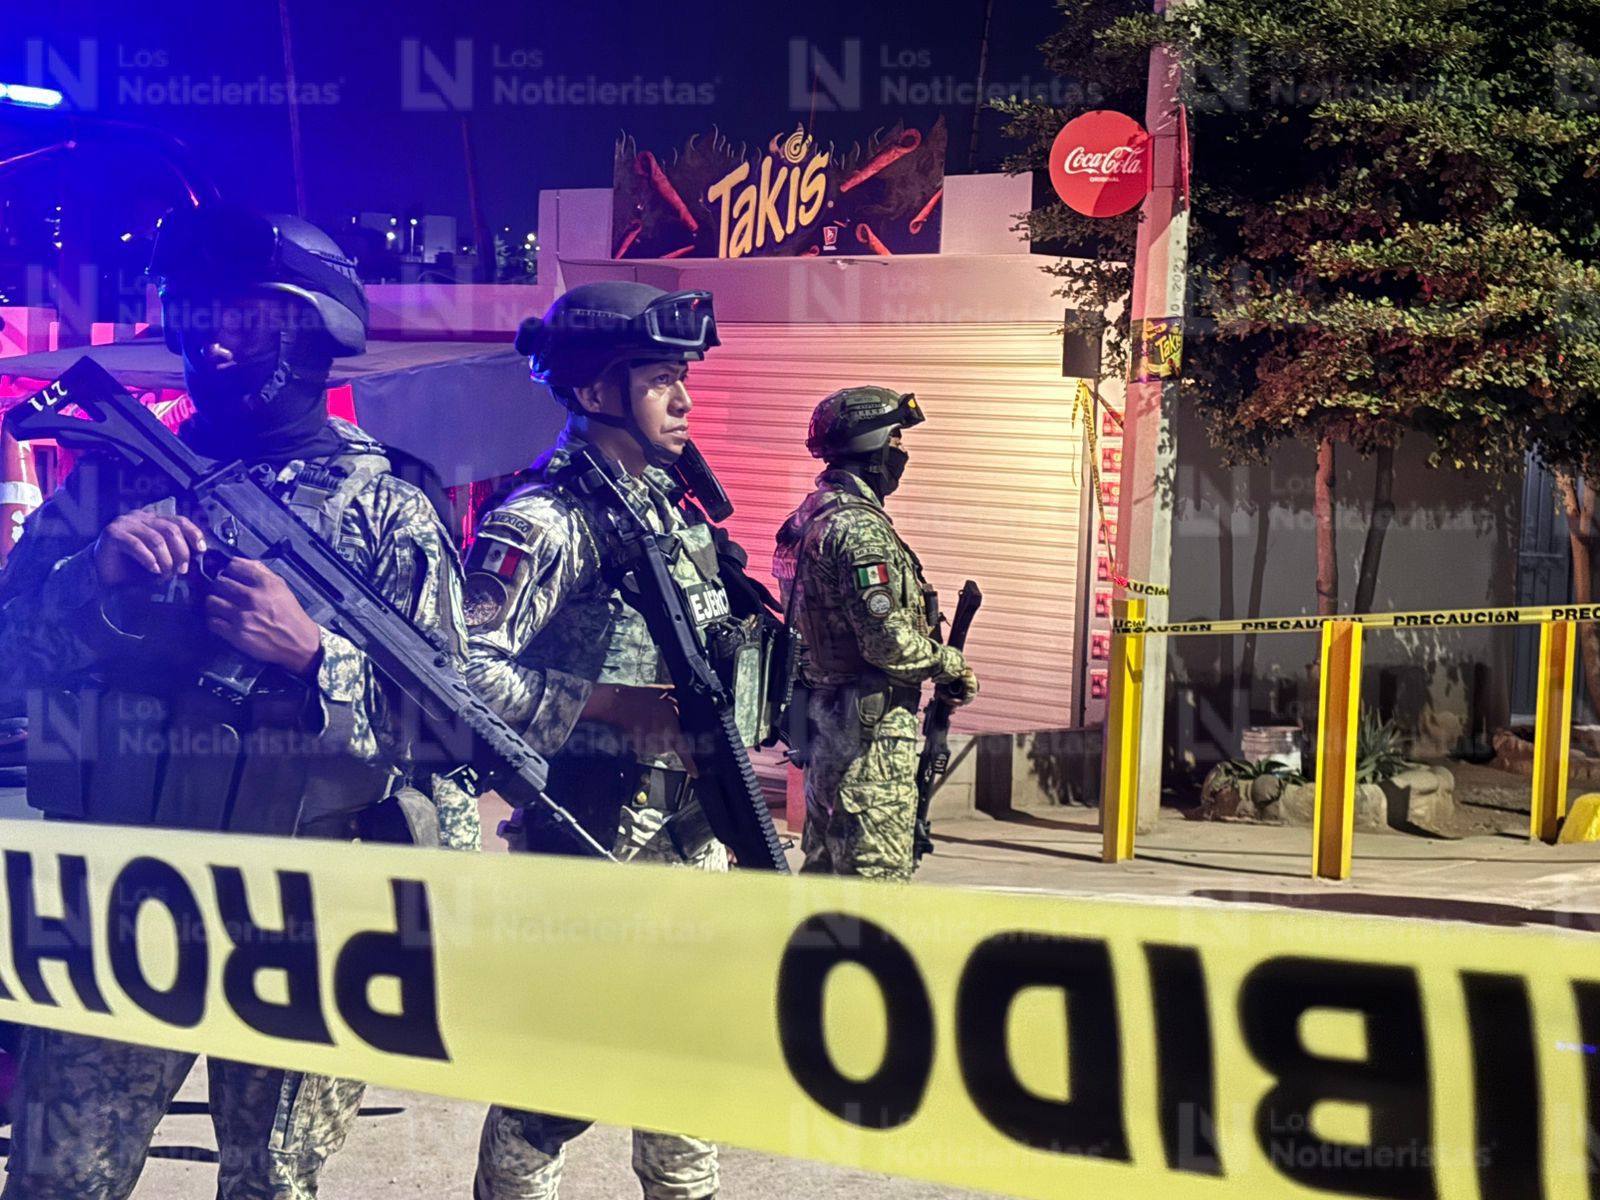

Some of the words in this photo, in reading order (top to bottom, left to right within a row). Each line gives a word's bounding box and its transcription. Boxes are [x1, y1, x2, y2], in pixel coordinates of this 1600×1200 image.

[707, 133, 829, 258] Takis
[1064, 146, 1146, 175] Coca-Cola
[26, 379, 69, 412] 271
[775, 911, 1600, 1200] IBIDO
